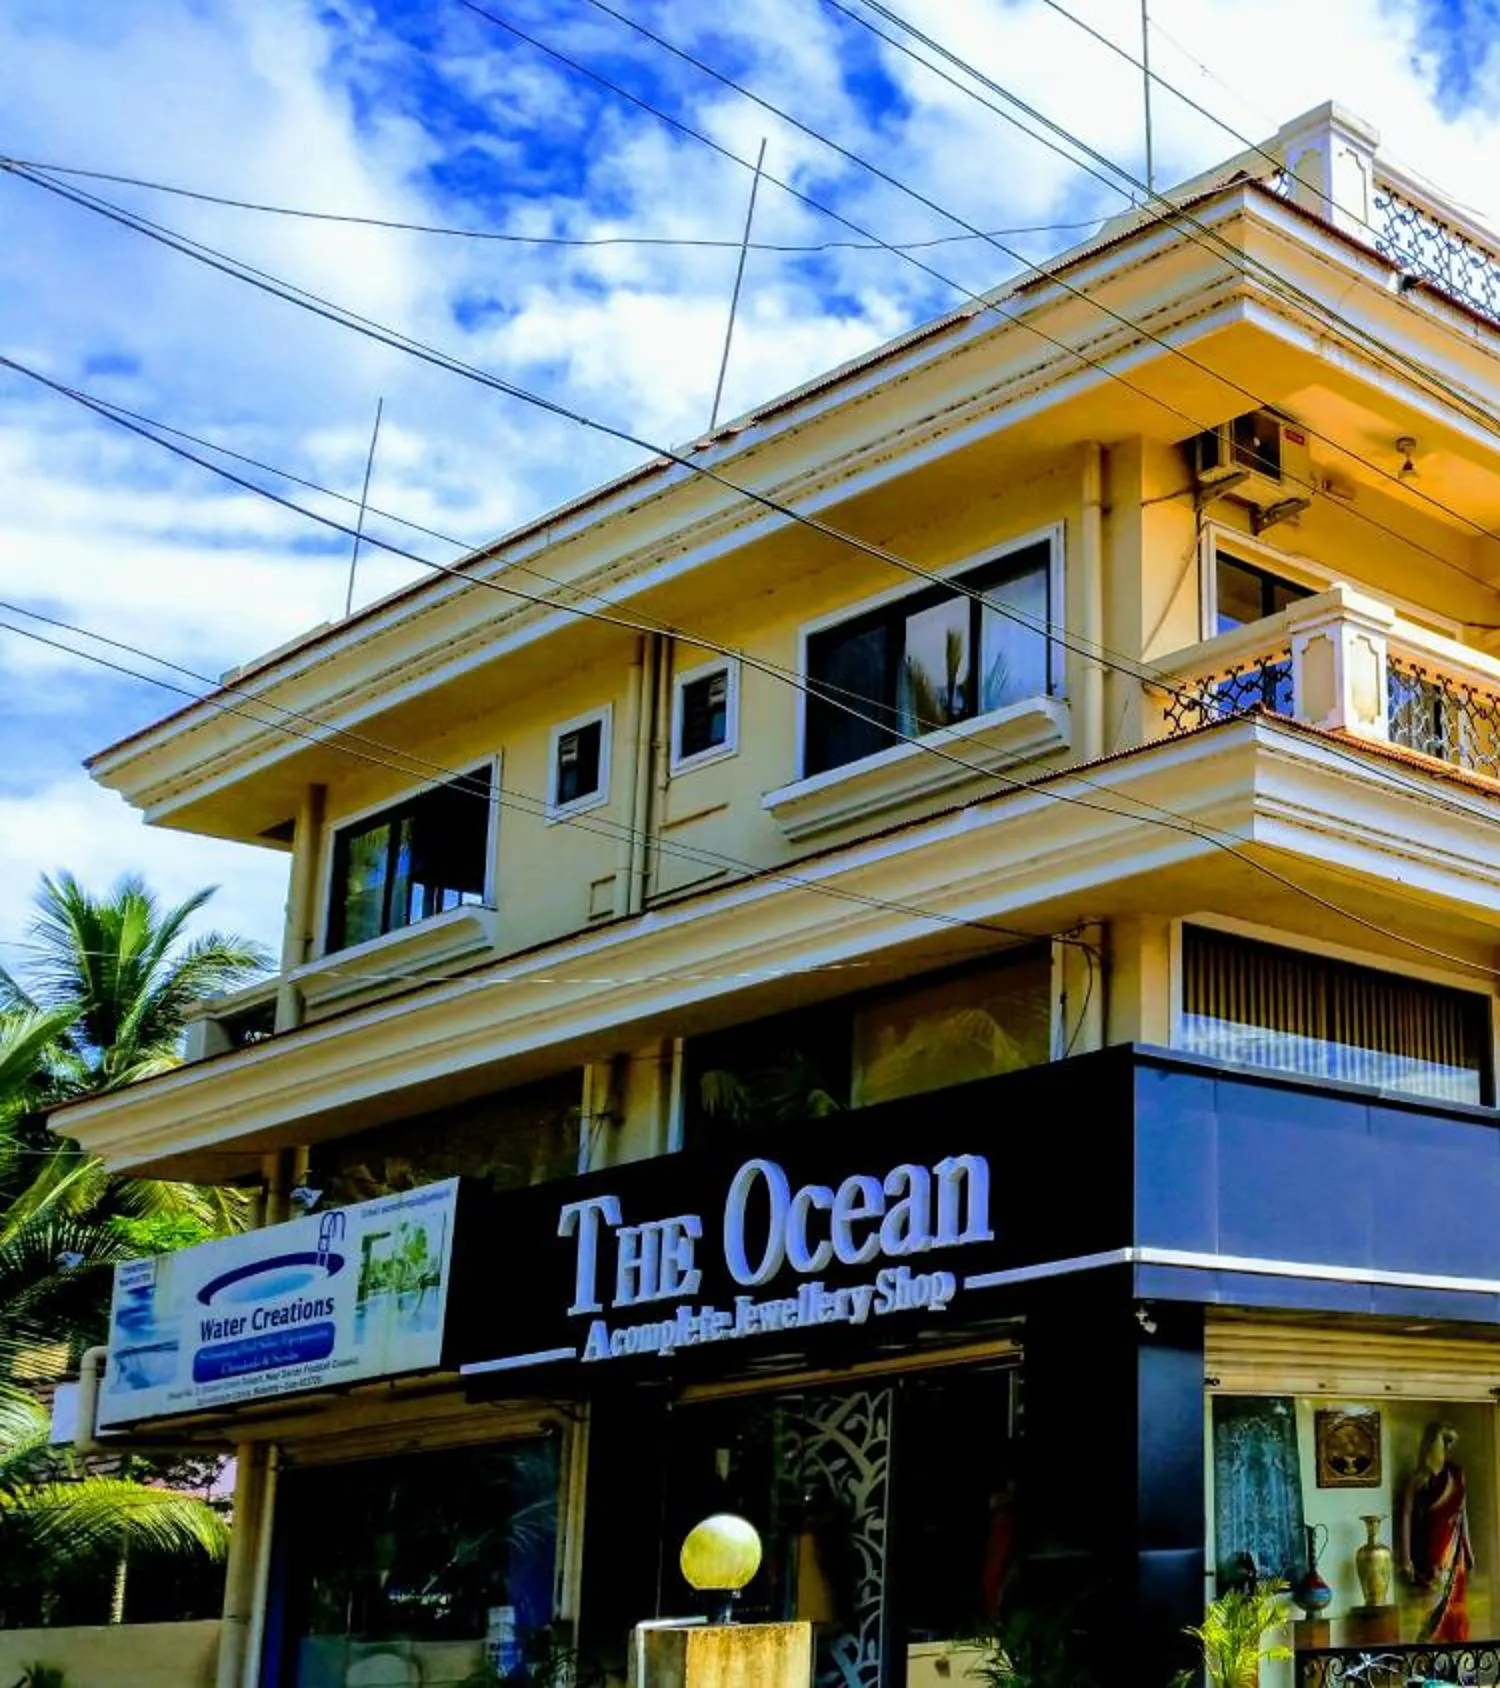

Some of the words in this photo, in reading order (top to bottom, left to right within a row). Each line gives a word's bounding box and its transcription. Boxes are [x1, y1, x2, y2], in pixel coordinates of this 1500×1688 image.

[558, 1195, 702, 1317] THE
[724, 1153, 995, 1286] Ocean
[200, 1317, 247, 1342] Water
[252, 1297, 335, 1331] Creations
[580, 1319, 611, 1362] A
[610, 1305, 733, 1356] complete
[730, 1280, 876, 1339] Jewellery
[874, 1265, 956, 1316] Shop
